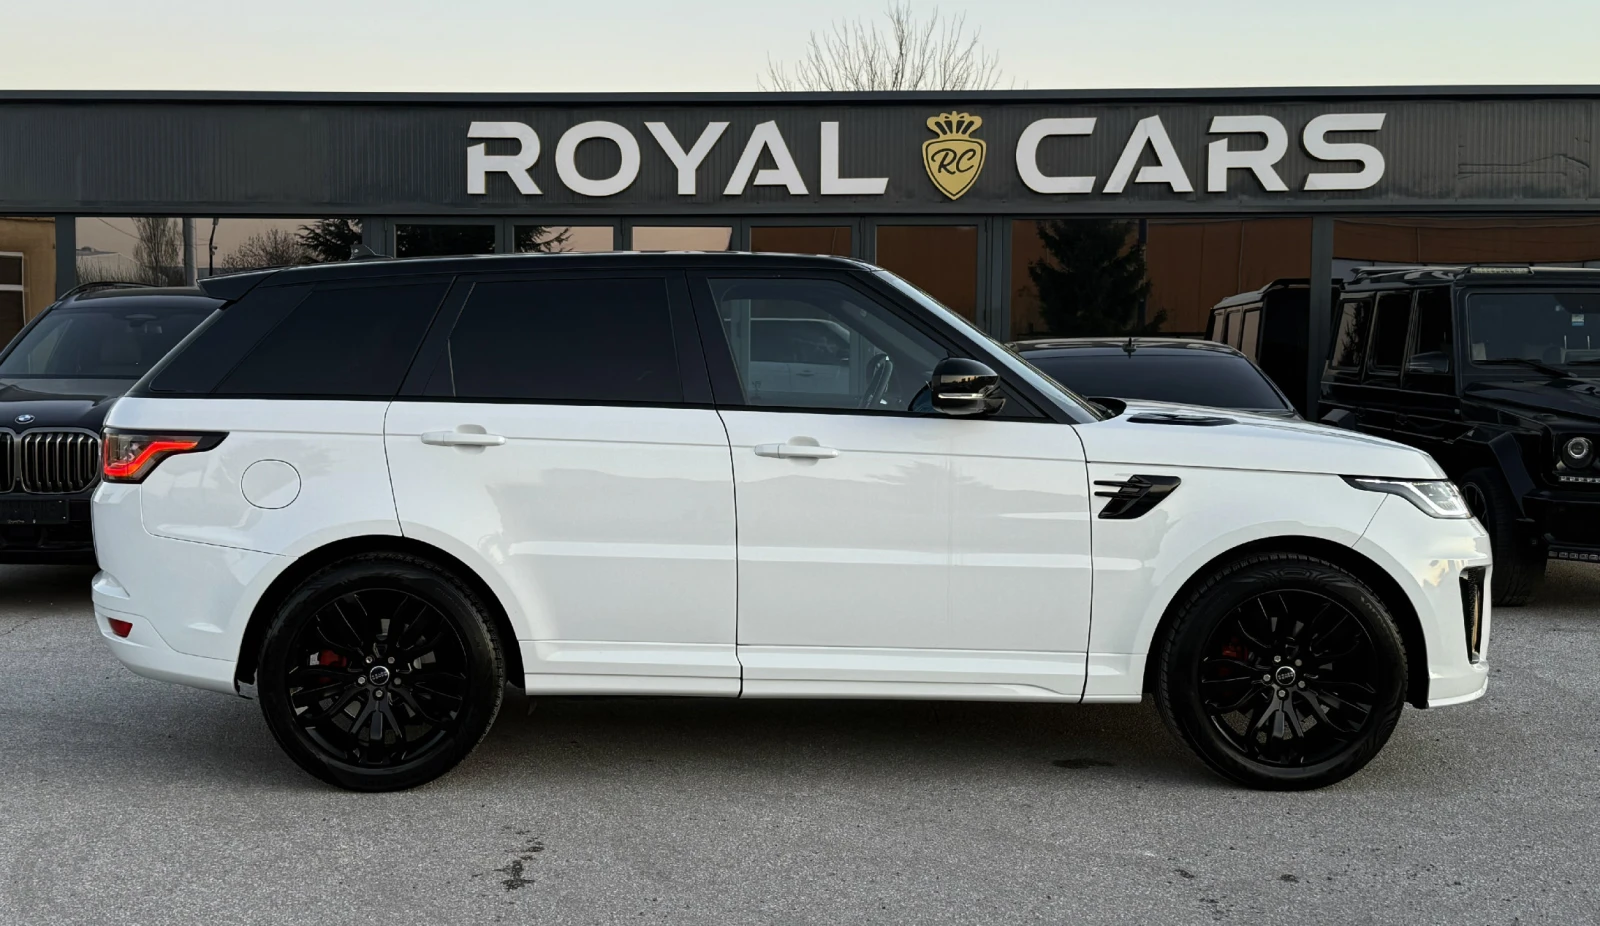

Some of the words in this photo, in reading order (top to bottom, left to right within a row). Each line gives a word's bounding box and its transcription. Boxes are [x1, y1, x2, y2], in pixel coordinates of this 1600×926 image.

[467, 120, 889, 197] ROYAL
[1015, 113, 1387, 194] CARS
[931, 148, 976, 175] RC
